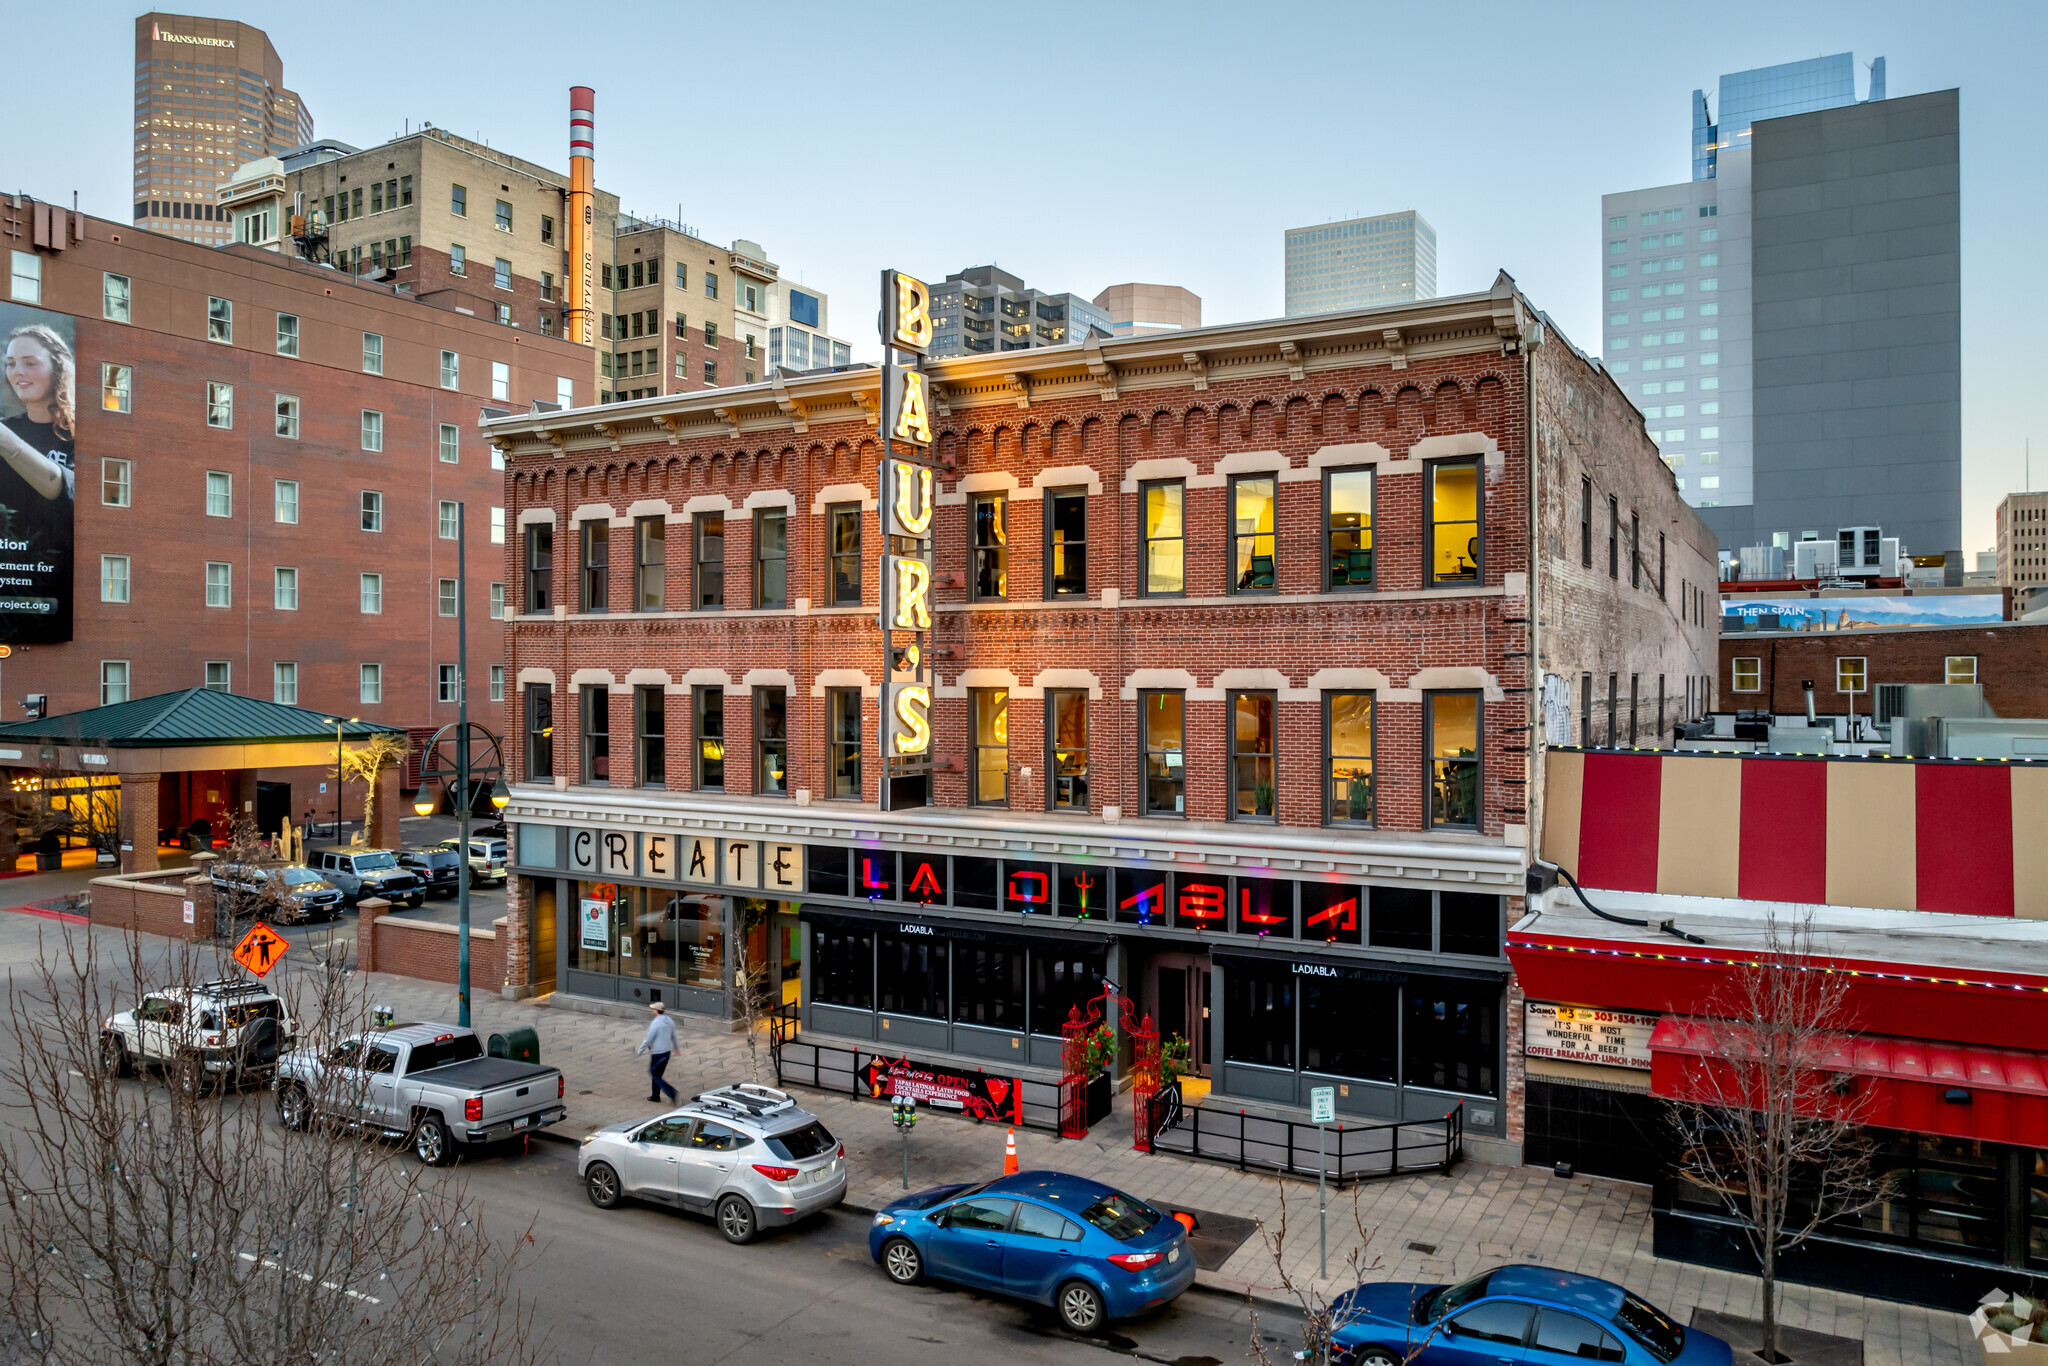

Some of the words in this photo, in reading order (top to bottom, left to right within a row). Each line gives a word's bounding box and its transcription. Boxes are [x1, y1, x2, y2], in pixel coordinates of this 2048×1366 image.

[160, 31, 235, 48] TRANSAMERICA
[37, 561, 54, 572] for
[1737, 607, 1767, 616] THEN
[574, 831, 792, 885] CREATE
[863, 858, 942, 894] LA
[1530, 1004, 1557, 1016] Sam's
[1554, 1021, 1571, 1030] IT'S
[1579, 1023, 1593, 1033] THE
[1600, 1026, 1622, 1036] MOST
[1546, 1029, 1592, 1042] WONDERFUL
[1605, 1036, 1626, 1045] TIME
[1561, 1040, 1576, 1049] FOR
[1584, 1043, 1590, 1051] A
[895, 1079, 912, 1087] TAPAS
[936, 1086, 953, 1094] LATIN
[954, 1089, 970, 1097] FOOD
[937, 1074, 970, 1090] OPEN
[895, 1084, 923, 1093] COCKTAILS
[924, 1089, 958, 1100] EXPERIENCE
[895, 1089, 911, 1097] LATIN
[911, 1092, 928, 1100] MUSIC
